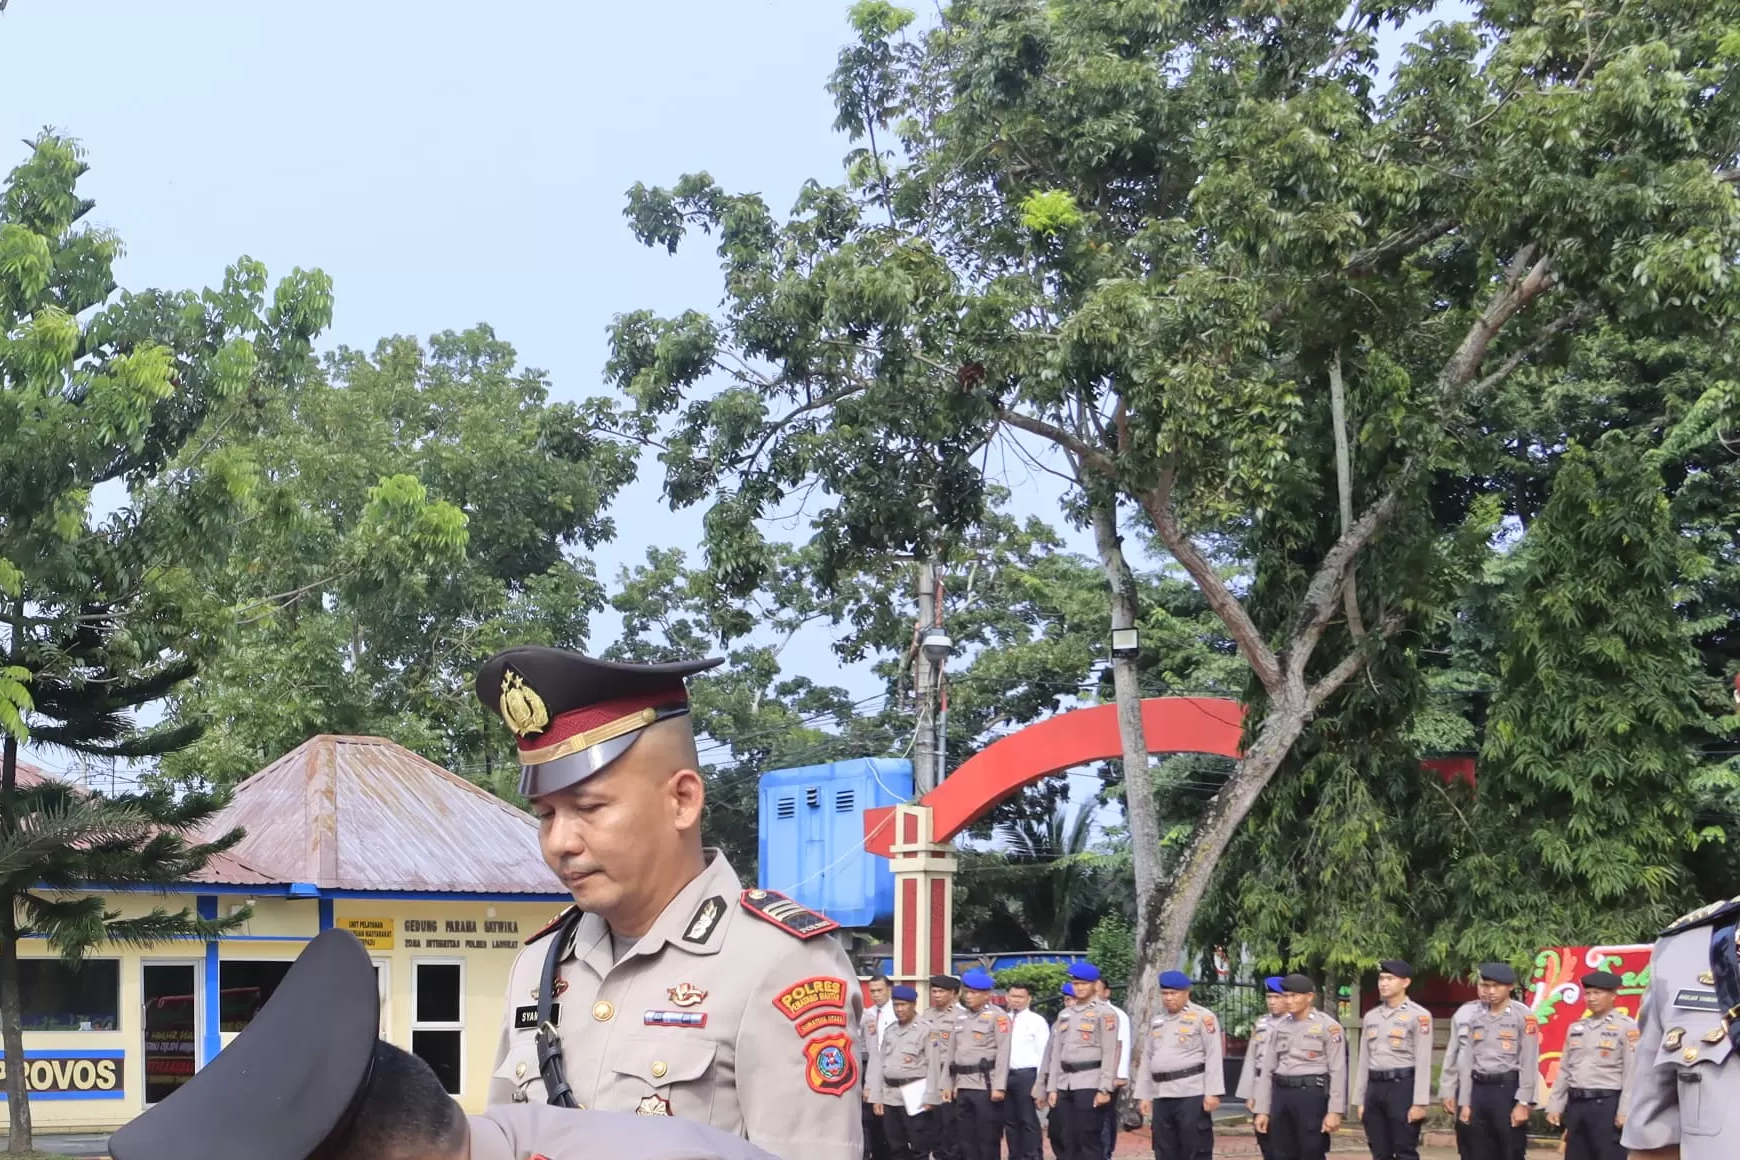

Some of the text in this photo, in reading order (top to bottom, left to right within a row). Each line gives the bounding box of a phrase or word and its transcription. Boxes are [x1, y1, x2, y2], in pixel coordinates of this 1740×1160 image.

[404, 920, 438, 933] GEDUNG
[445, 920, 477, 933] PARAMA
[781, 982, 840, 1007] POLRES
